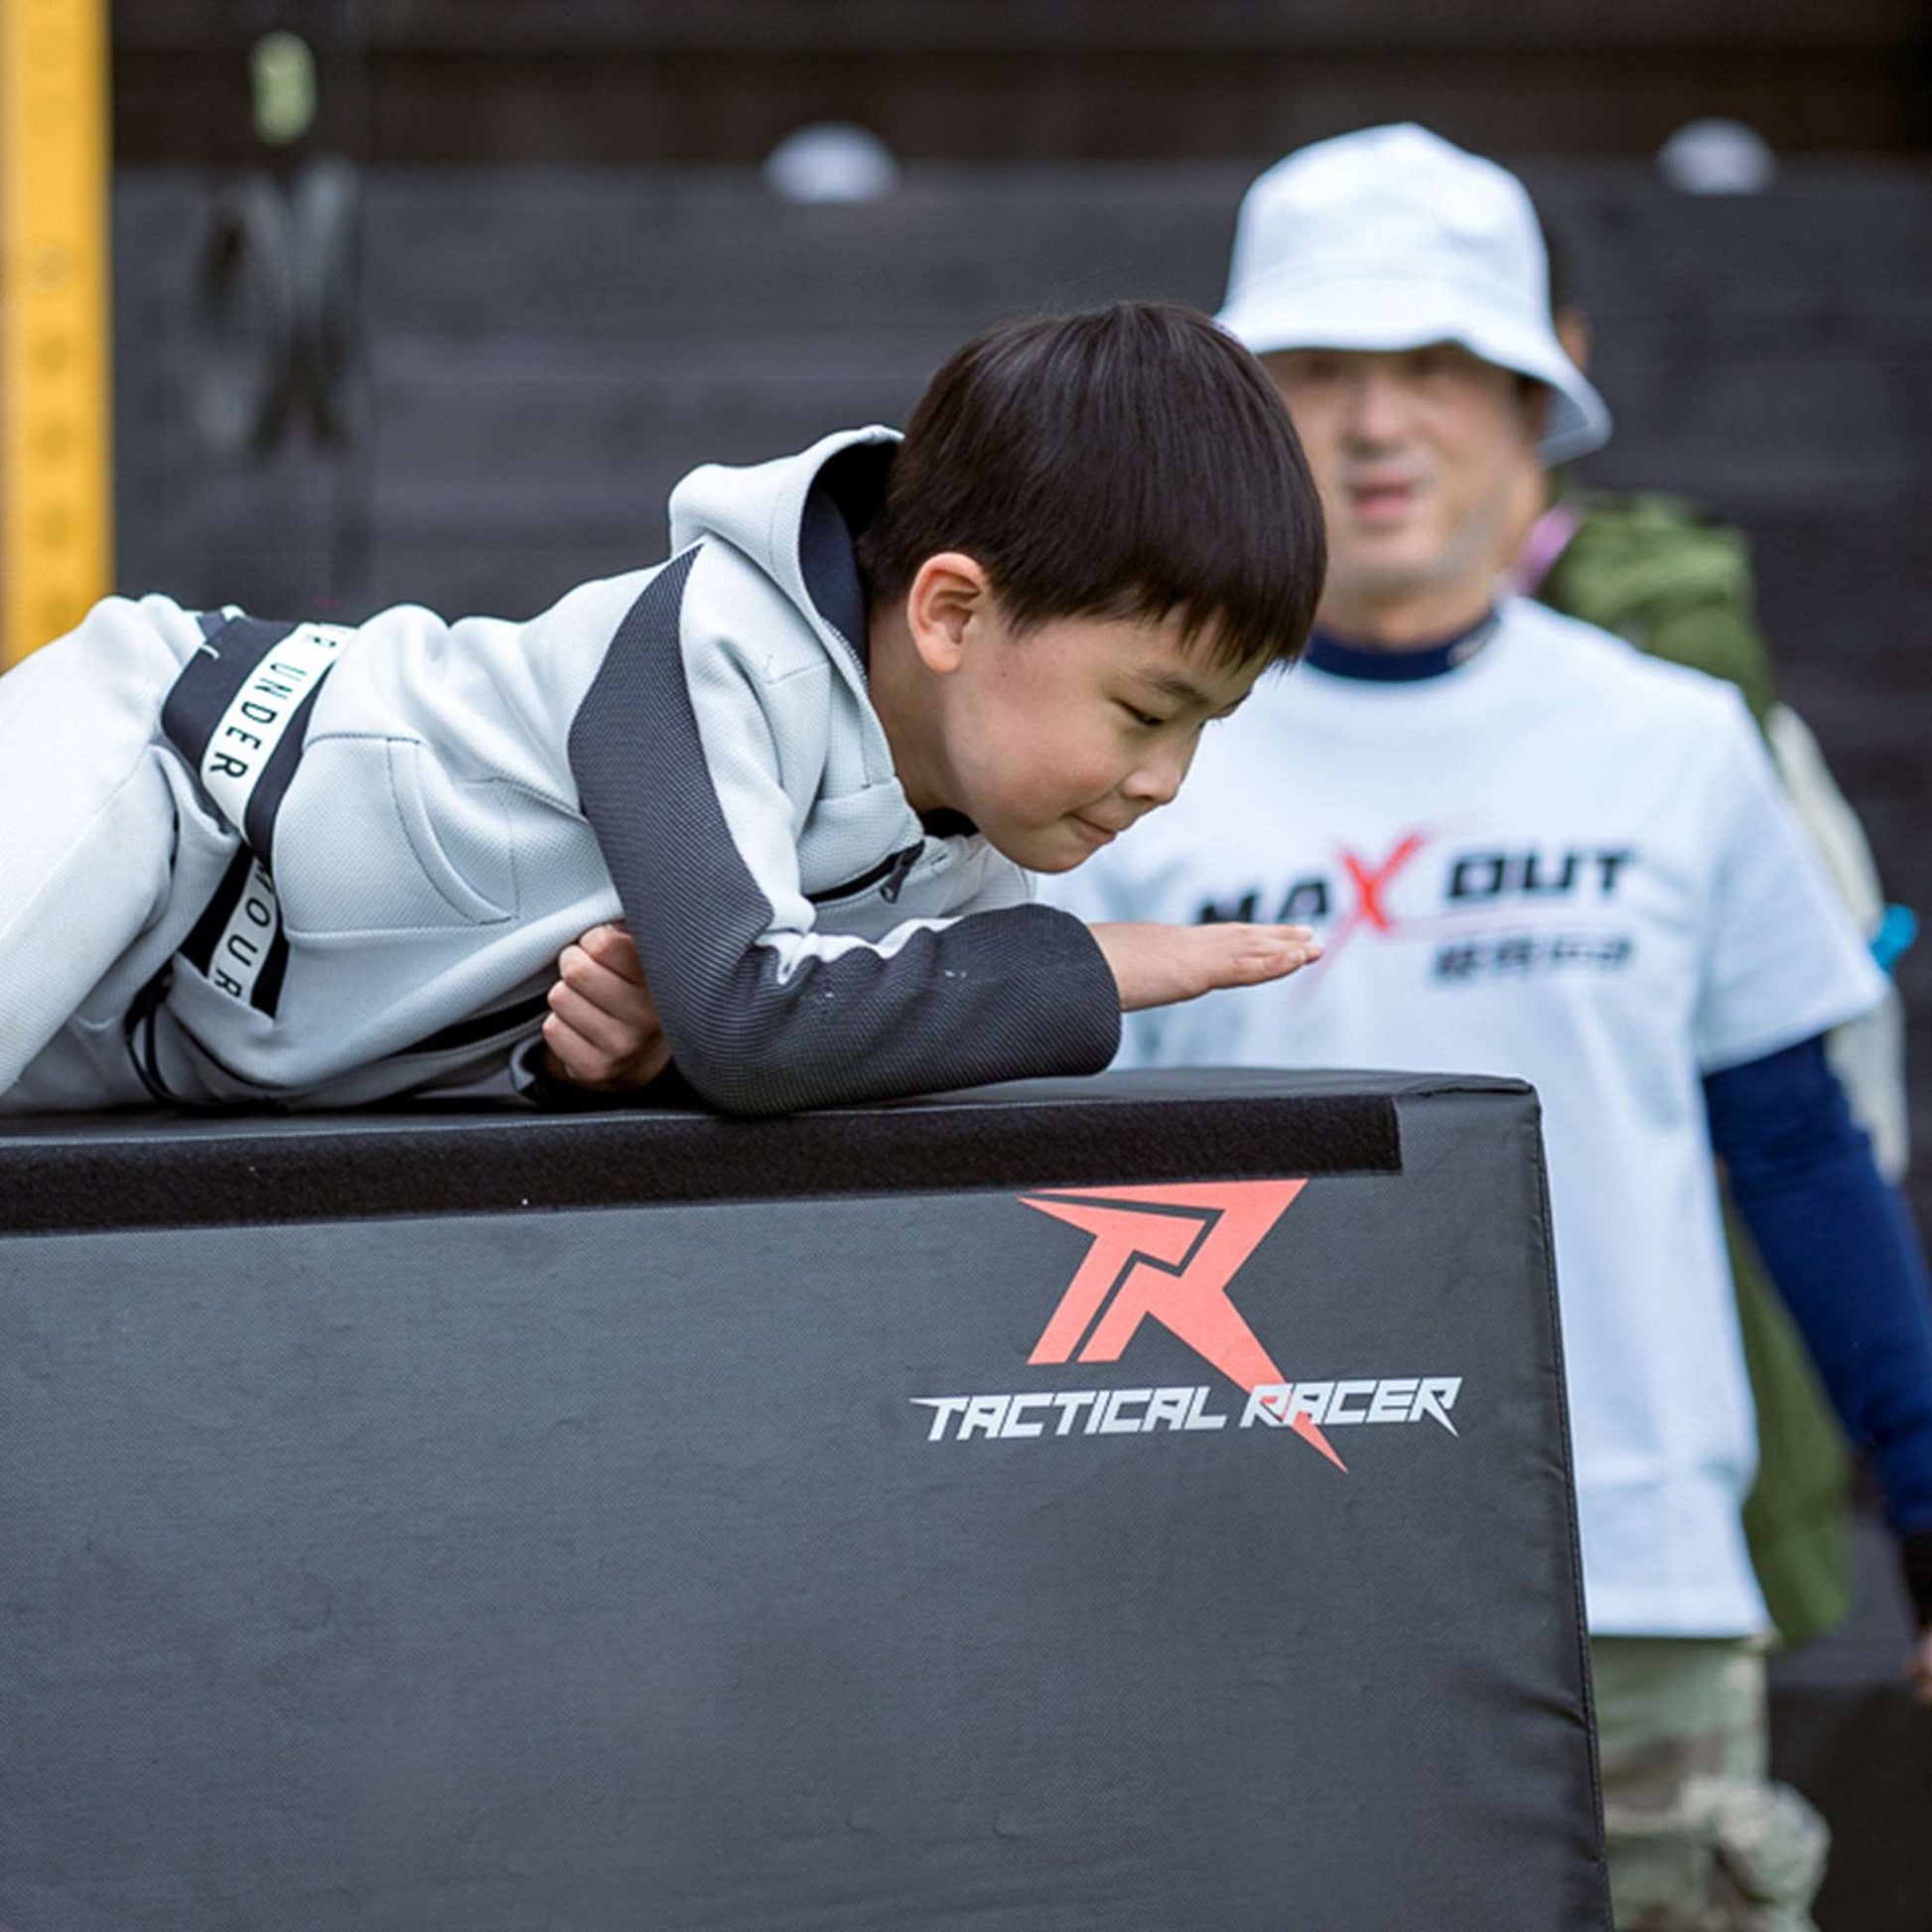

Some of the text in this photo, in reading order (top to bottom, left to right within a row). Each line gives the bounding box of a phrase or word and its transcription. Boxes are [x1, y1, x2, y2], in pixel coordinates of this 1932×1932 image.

[209, 662, 308, 778] UNDER
[1197, 833, 1633, 935] MAX OUT
[908, 1377, 1462, 1441] TACTICAL RACER
